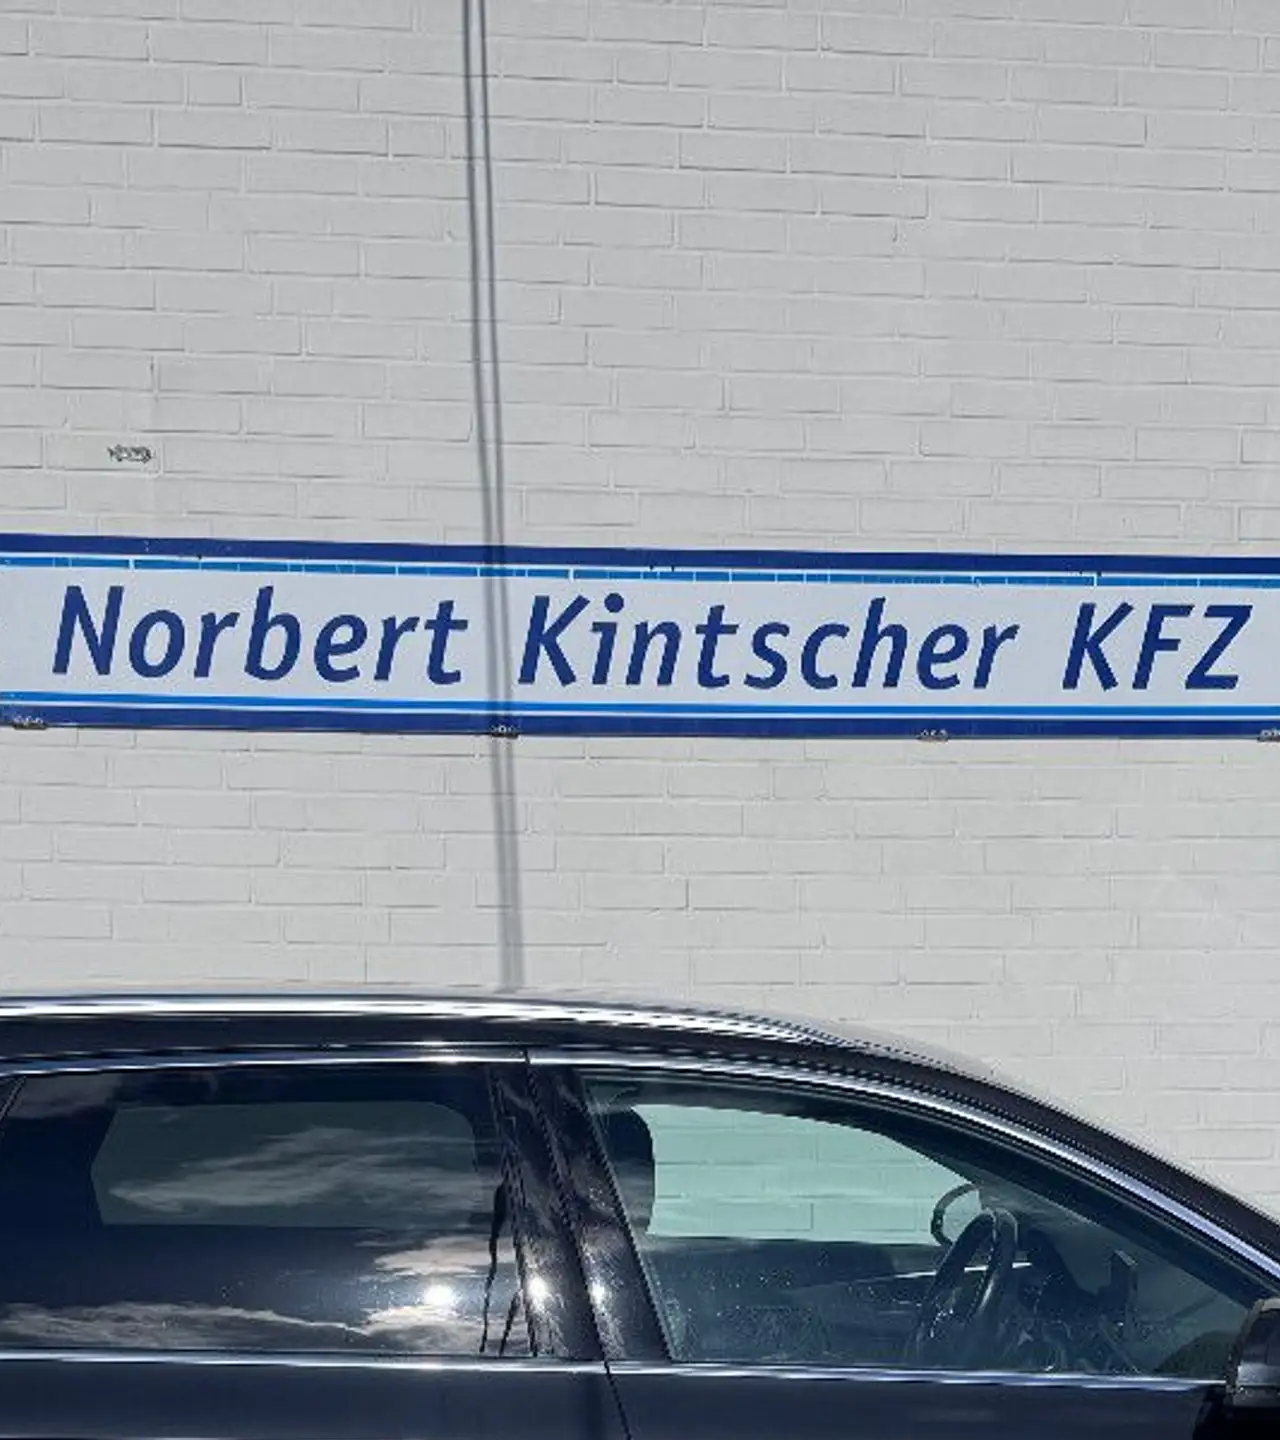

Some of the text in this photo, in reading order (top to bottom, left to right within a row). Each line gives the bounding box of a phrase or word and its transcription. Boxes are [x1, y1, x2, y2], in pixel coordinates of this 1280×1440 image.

[52, 585, 1254, 692] Norbert Kintscher KFZ
